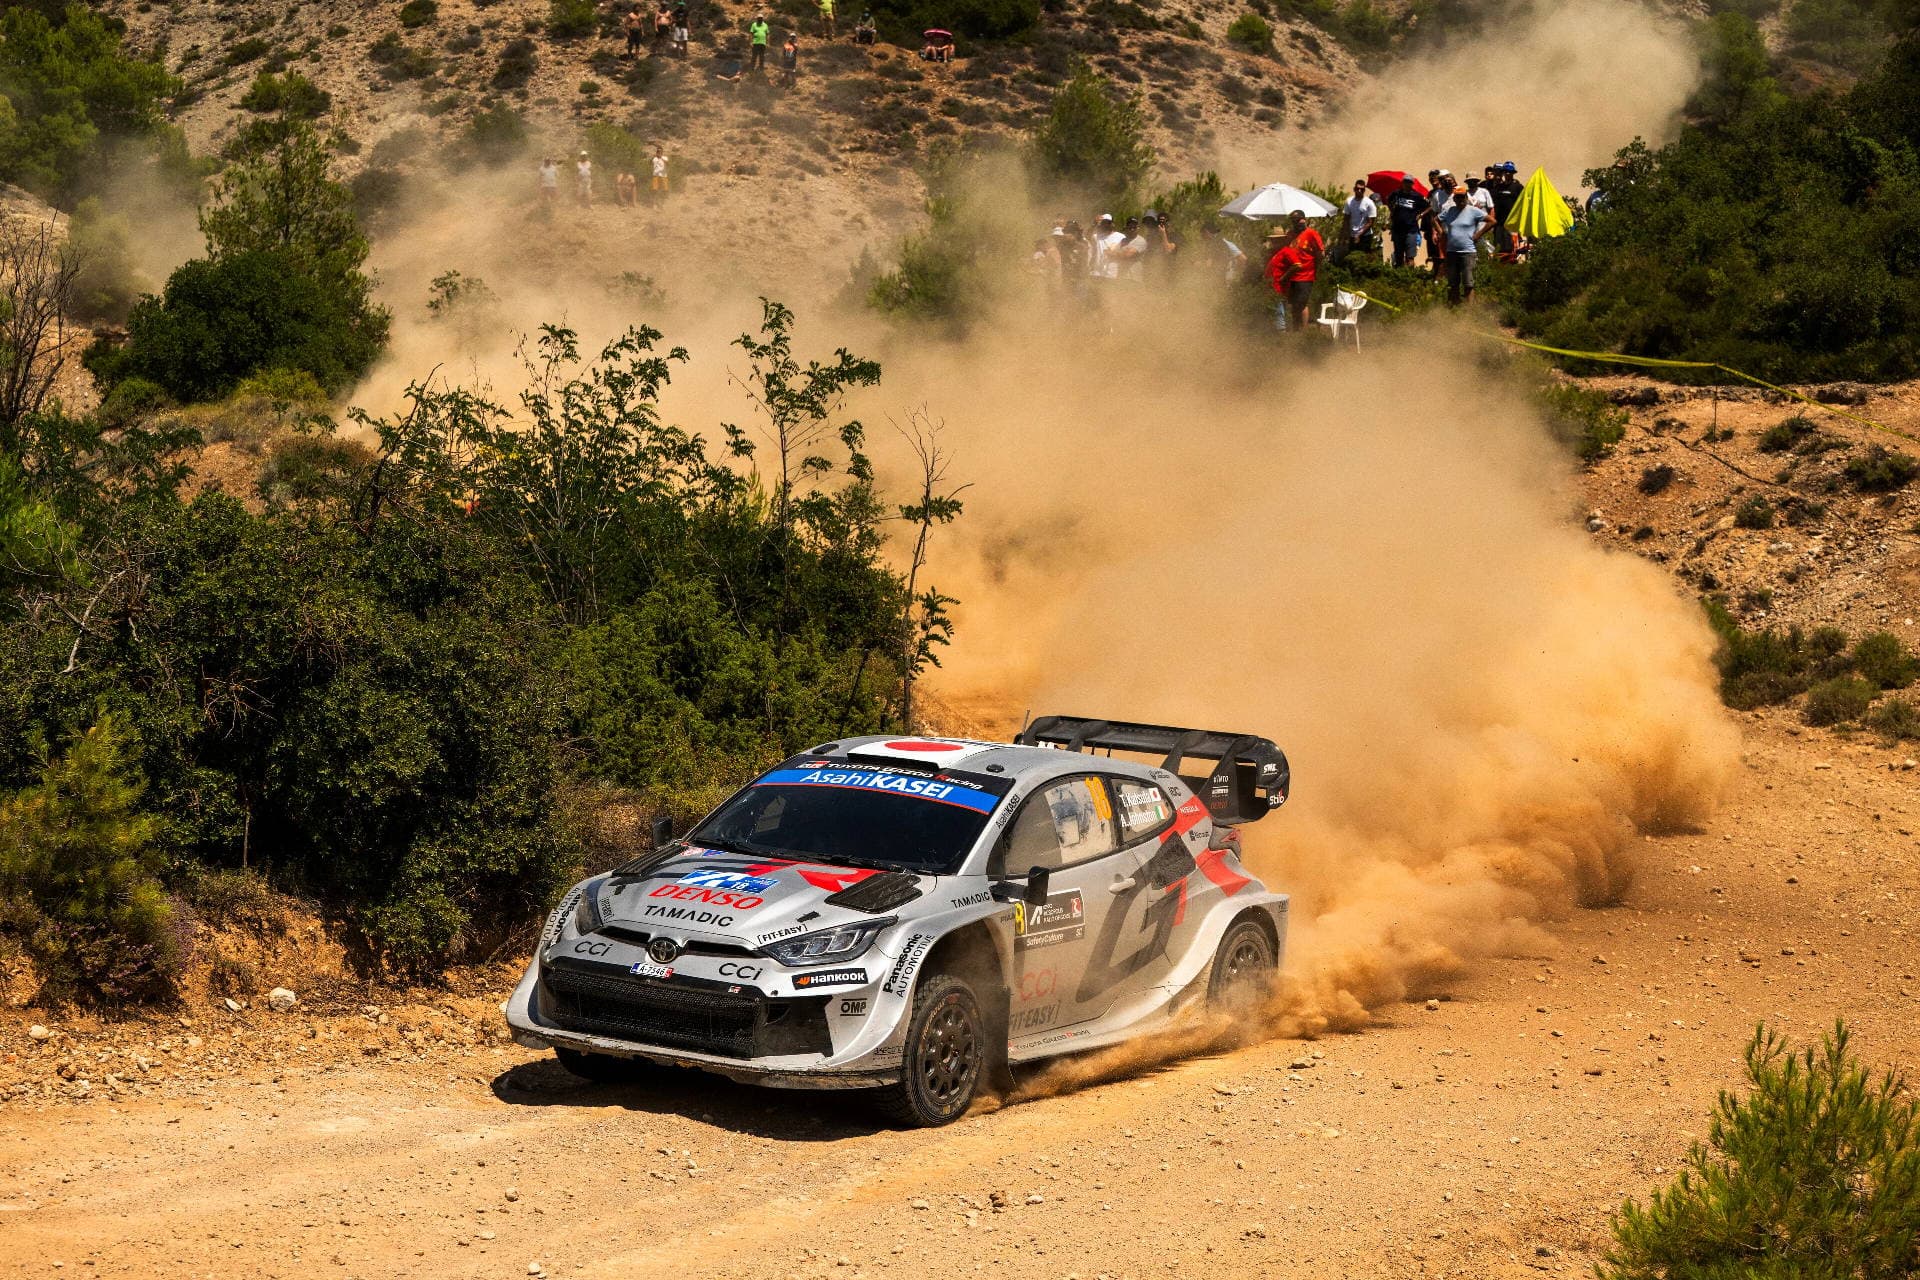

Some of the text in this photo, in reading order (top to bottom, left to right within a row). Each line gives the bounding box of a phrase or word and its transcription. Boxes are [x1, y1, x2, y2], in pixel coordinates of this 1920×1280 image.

[829, 763, 881, 774] TOYOTA
[935, 774, 984, 790] Racing
[1085, 776, 1113, 822] 18
[648, 884, 765, 910] DENSO
[730, 881, 749, 890] 18
[951, 891, 991, 909] TAMADIC
[644, 905, 734, 927] TAMADIC
[882, 933, 923, 993] Panasonic
[896, 934, 935, 998] AUTOMOTIVE
[840, 1001, 867, 1014] OMP
